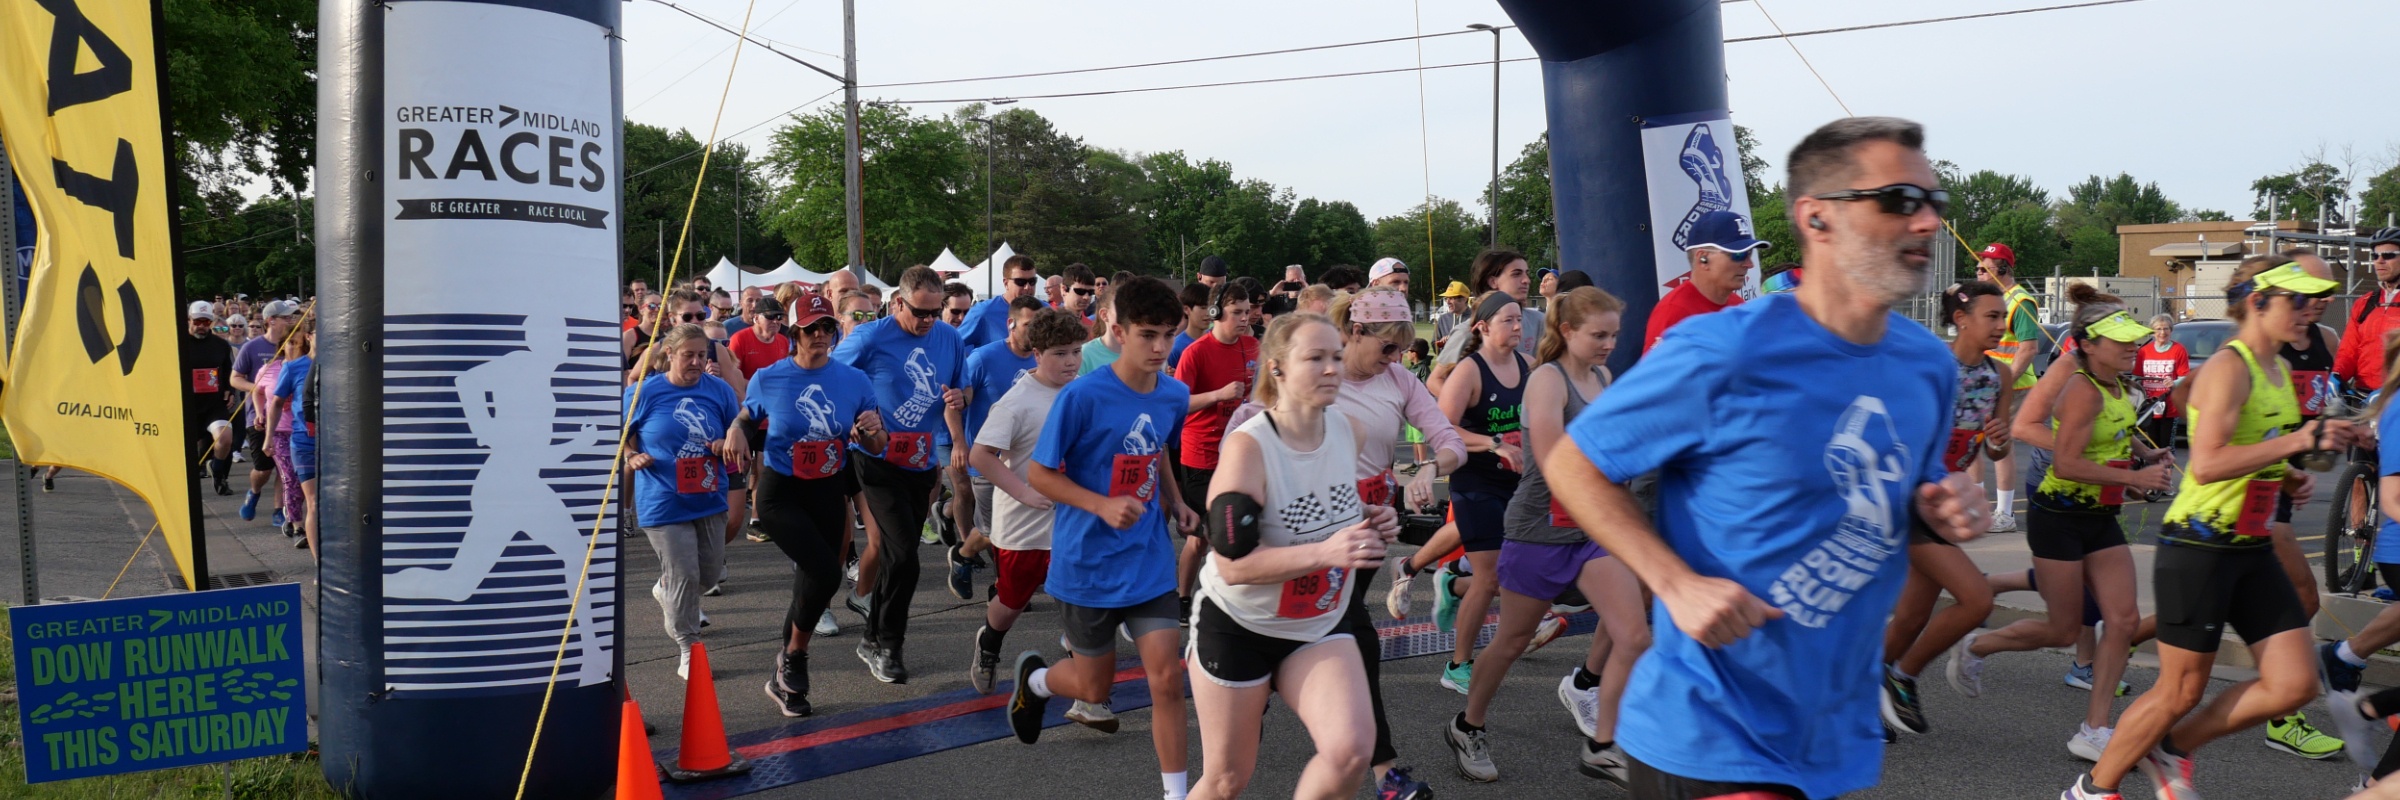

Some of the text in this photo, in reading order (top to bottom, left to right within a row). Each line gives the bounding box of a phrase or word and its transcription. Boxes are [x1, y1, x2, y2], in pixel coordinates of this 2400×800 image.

[397, 106, 600, 138] GREATER MIDLAND
[399, 128, 605, 193] RACES
[430, 201, 587, 221] BE GREATER RACE LOCAL
[896, 405, 924, 422] RUN
[903, 400, 928, 414] DOW
[1487, 405, 1514, 420] Red
[893, 411, 919, 428] WALK
[802, 451, 816, 465] 70
[895, 441, 909, 453] 68
[684, 466, 697, 479] 26
[1121, 468, 1140, 484] 115
[1801, 548, 1875, 592] DOW
[1293, 575, 1319, 597] 198
[1779, 562, 1854, 613] RUN
[1767, 580, 1835, 628] WALK
[26, 600, 290, 640] GREATER MIDLAND
[31, 623, 290, 686] DOW RUNWALK
[119, 673, 218, 721] HERE
[43, 706, 290, 771] THIS SATURDAY
